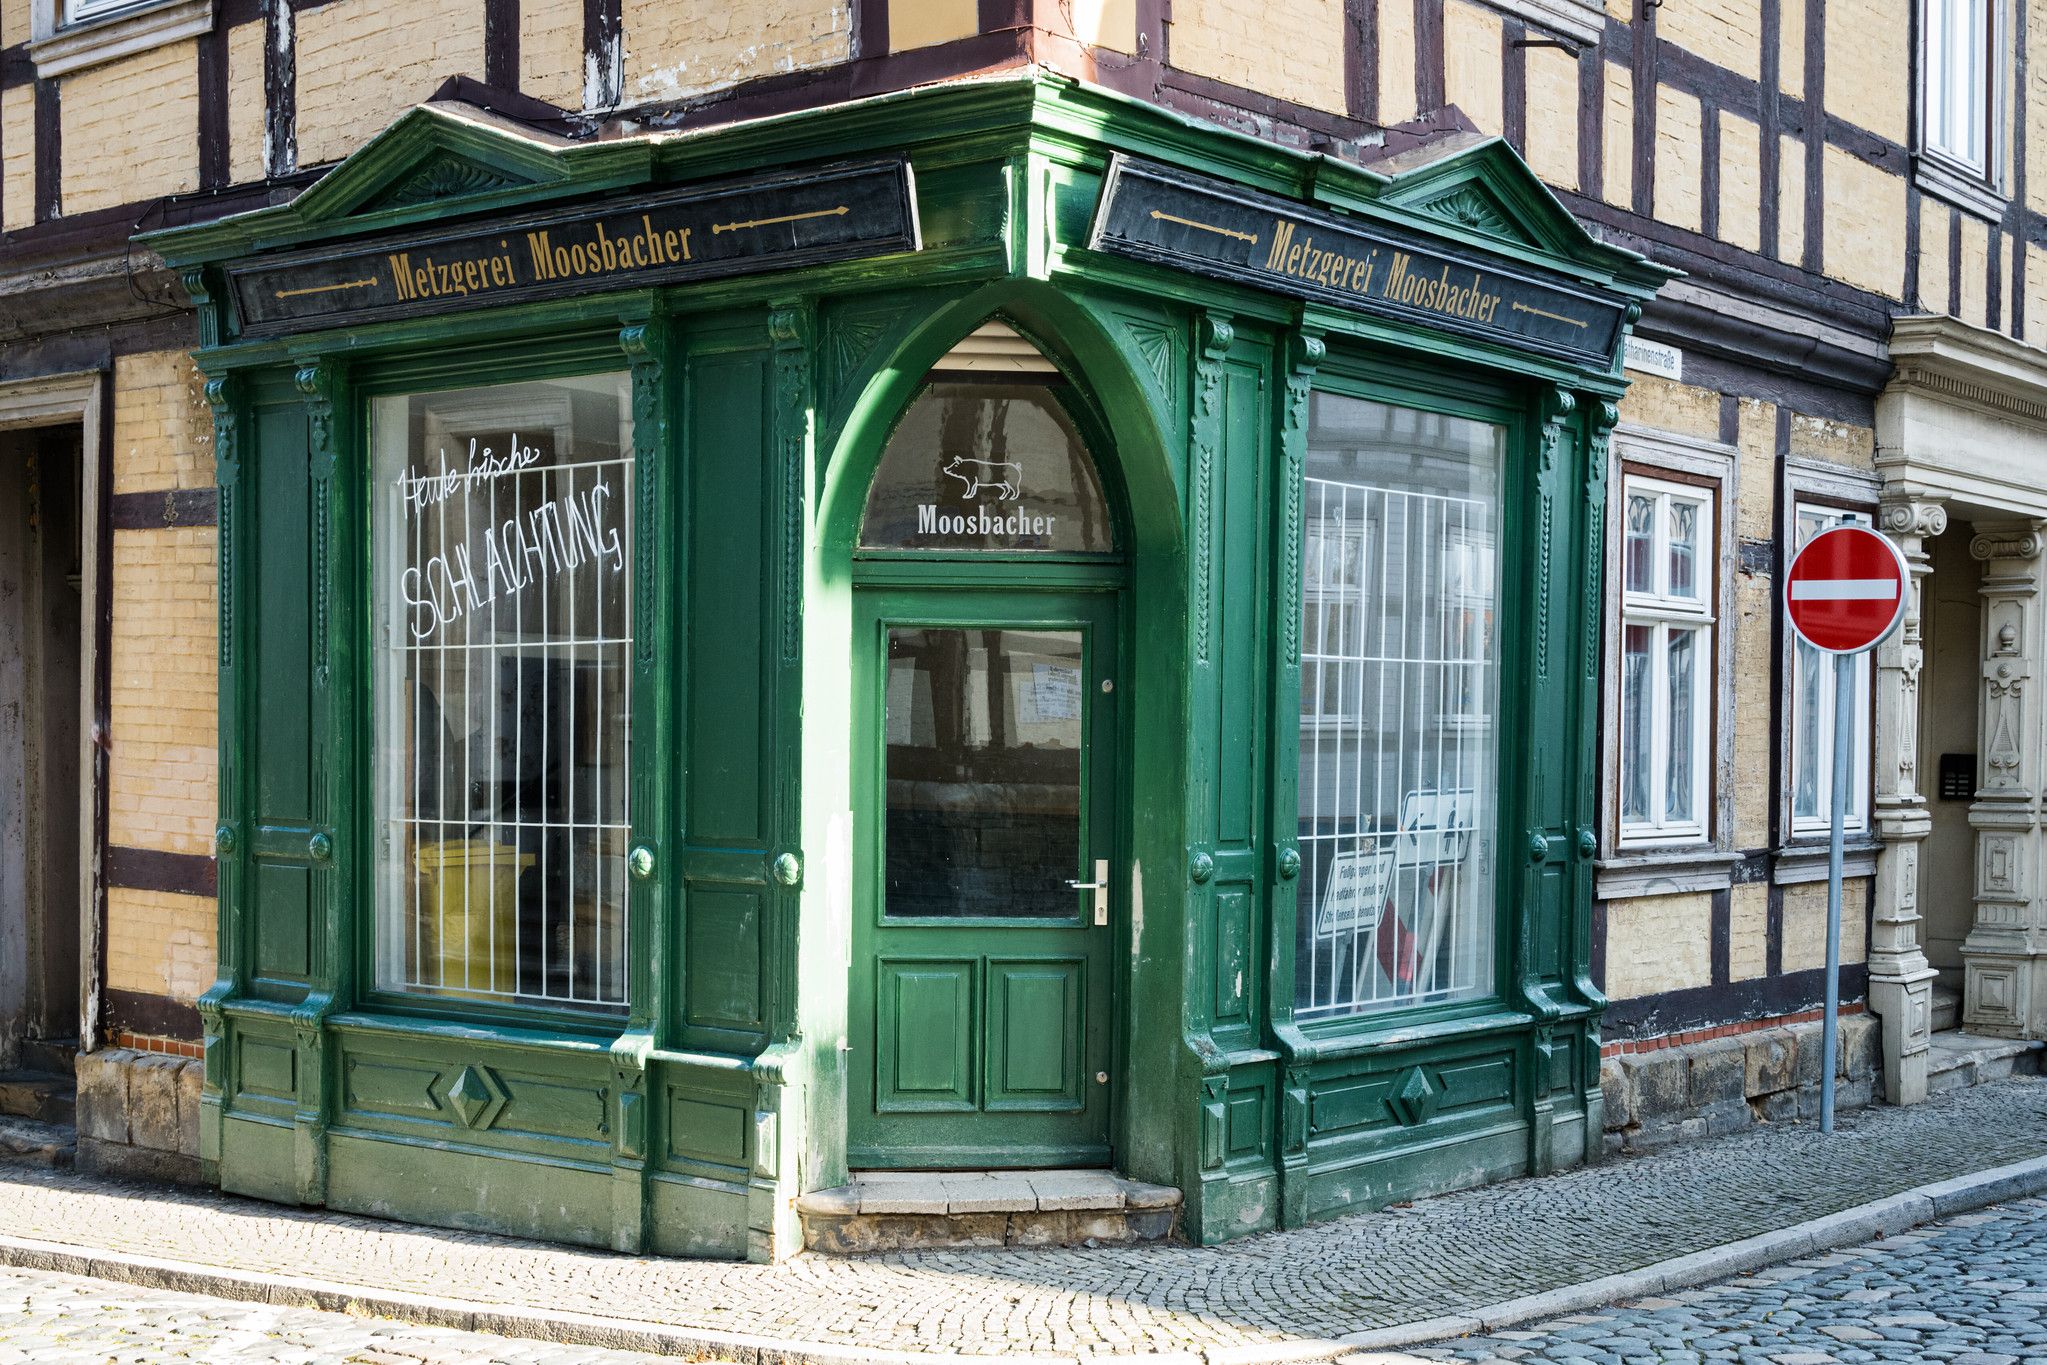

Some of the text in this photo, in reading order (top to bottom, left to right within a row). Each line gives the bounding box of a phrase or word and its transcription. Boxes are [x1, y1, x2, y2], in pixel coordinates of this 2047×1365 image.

[389, 215, 692, 300] Metzgerei Moosbacher
[1265, 220, 1501, 323] Metzgerei Moosbacher
[1624, 340, 1675, 370] atharinenstraße
[396, 448, 461, 519] Heute
[917, 504, 1056, 535] Moosbacher
[401, 481, 623, 638] SCHLACHTUNG
